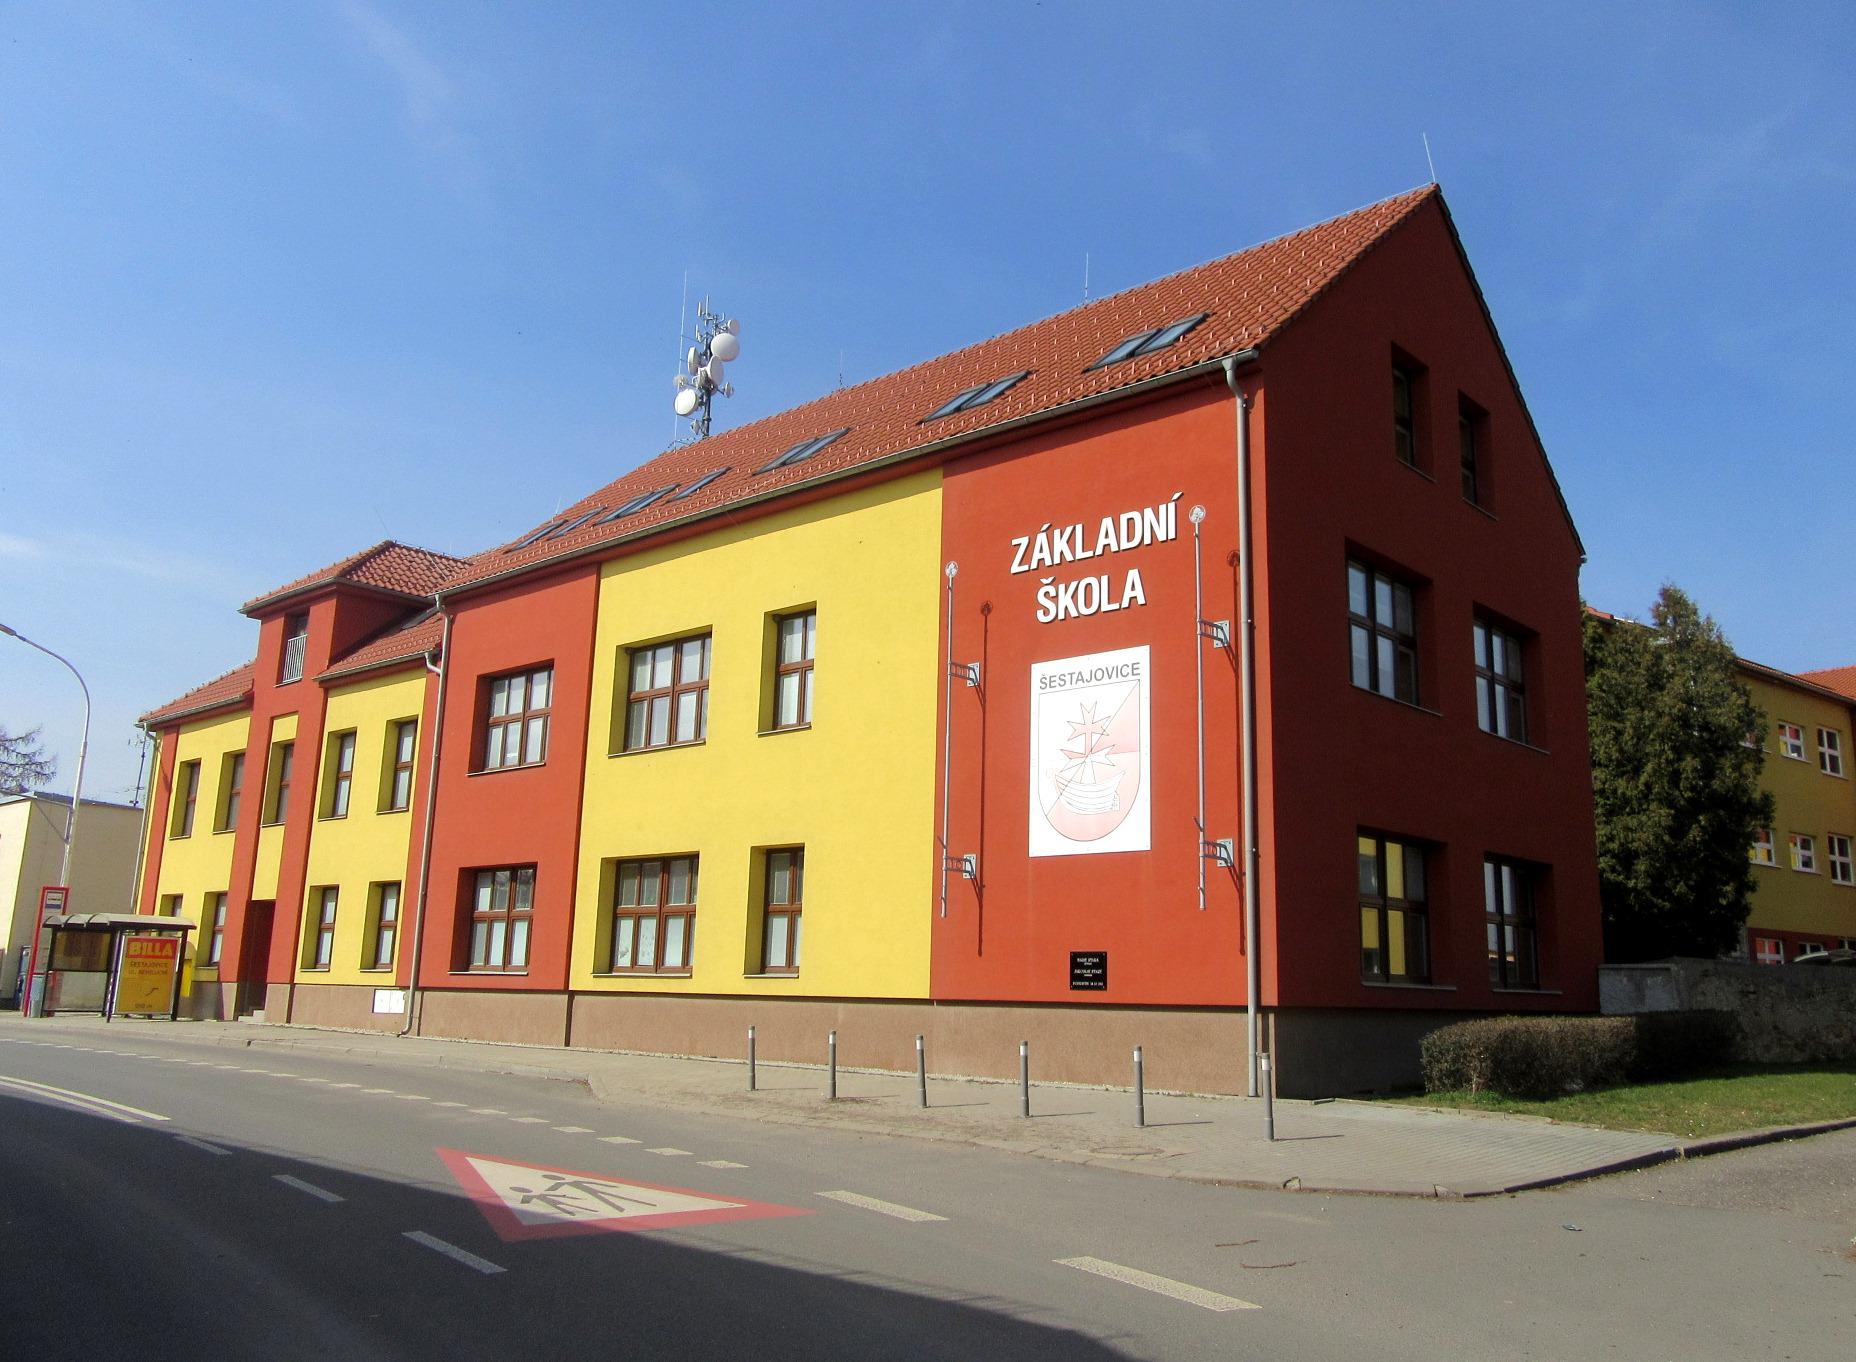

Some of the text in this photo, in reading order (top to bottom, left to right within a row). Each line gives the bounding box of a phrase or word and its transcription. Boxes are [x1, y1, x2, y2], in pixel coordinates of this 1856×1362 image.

[1010, 491, 1184, 574] ZÁKLADNÍ
[1036, 568, 1147, 624] ŠKOLA
[1039, 662, 1141, 690] ŠESTAJOVICE
[127, 941, 173, 956] BILLA
